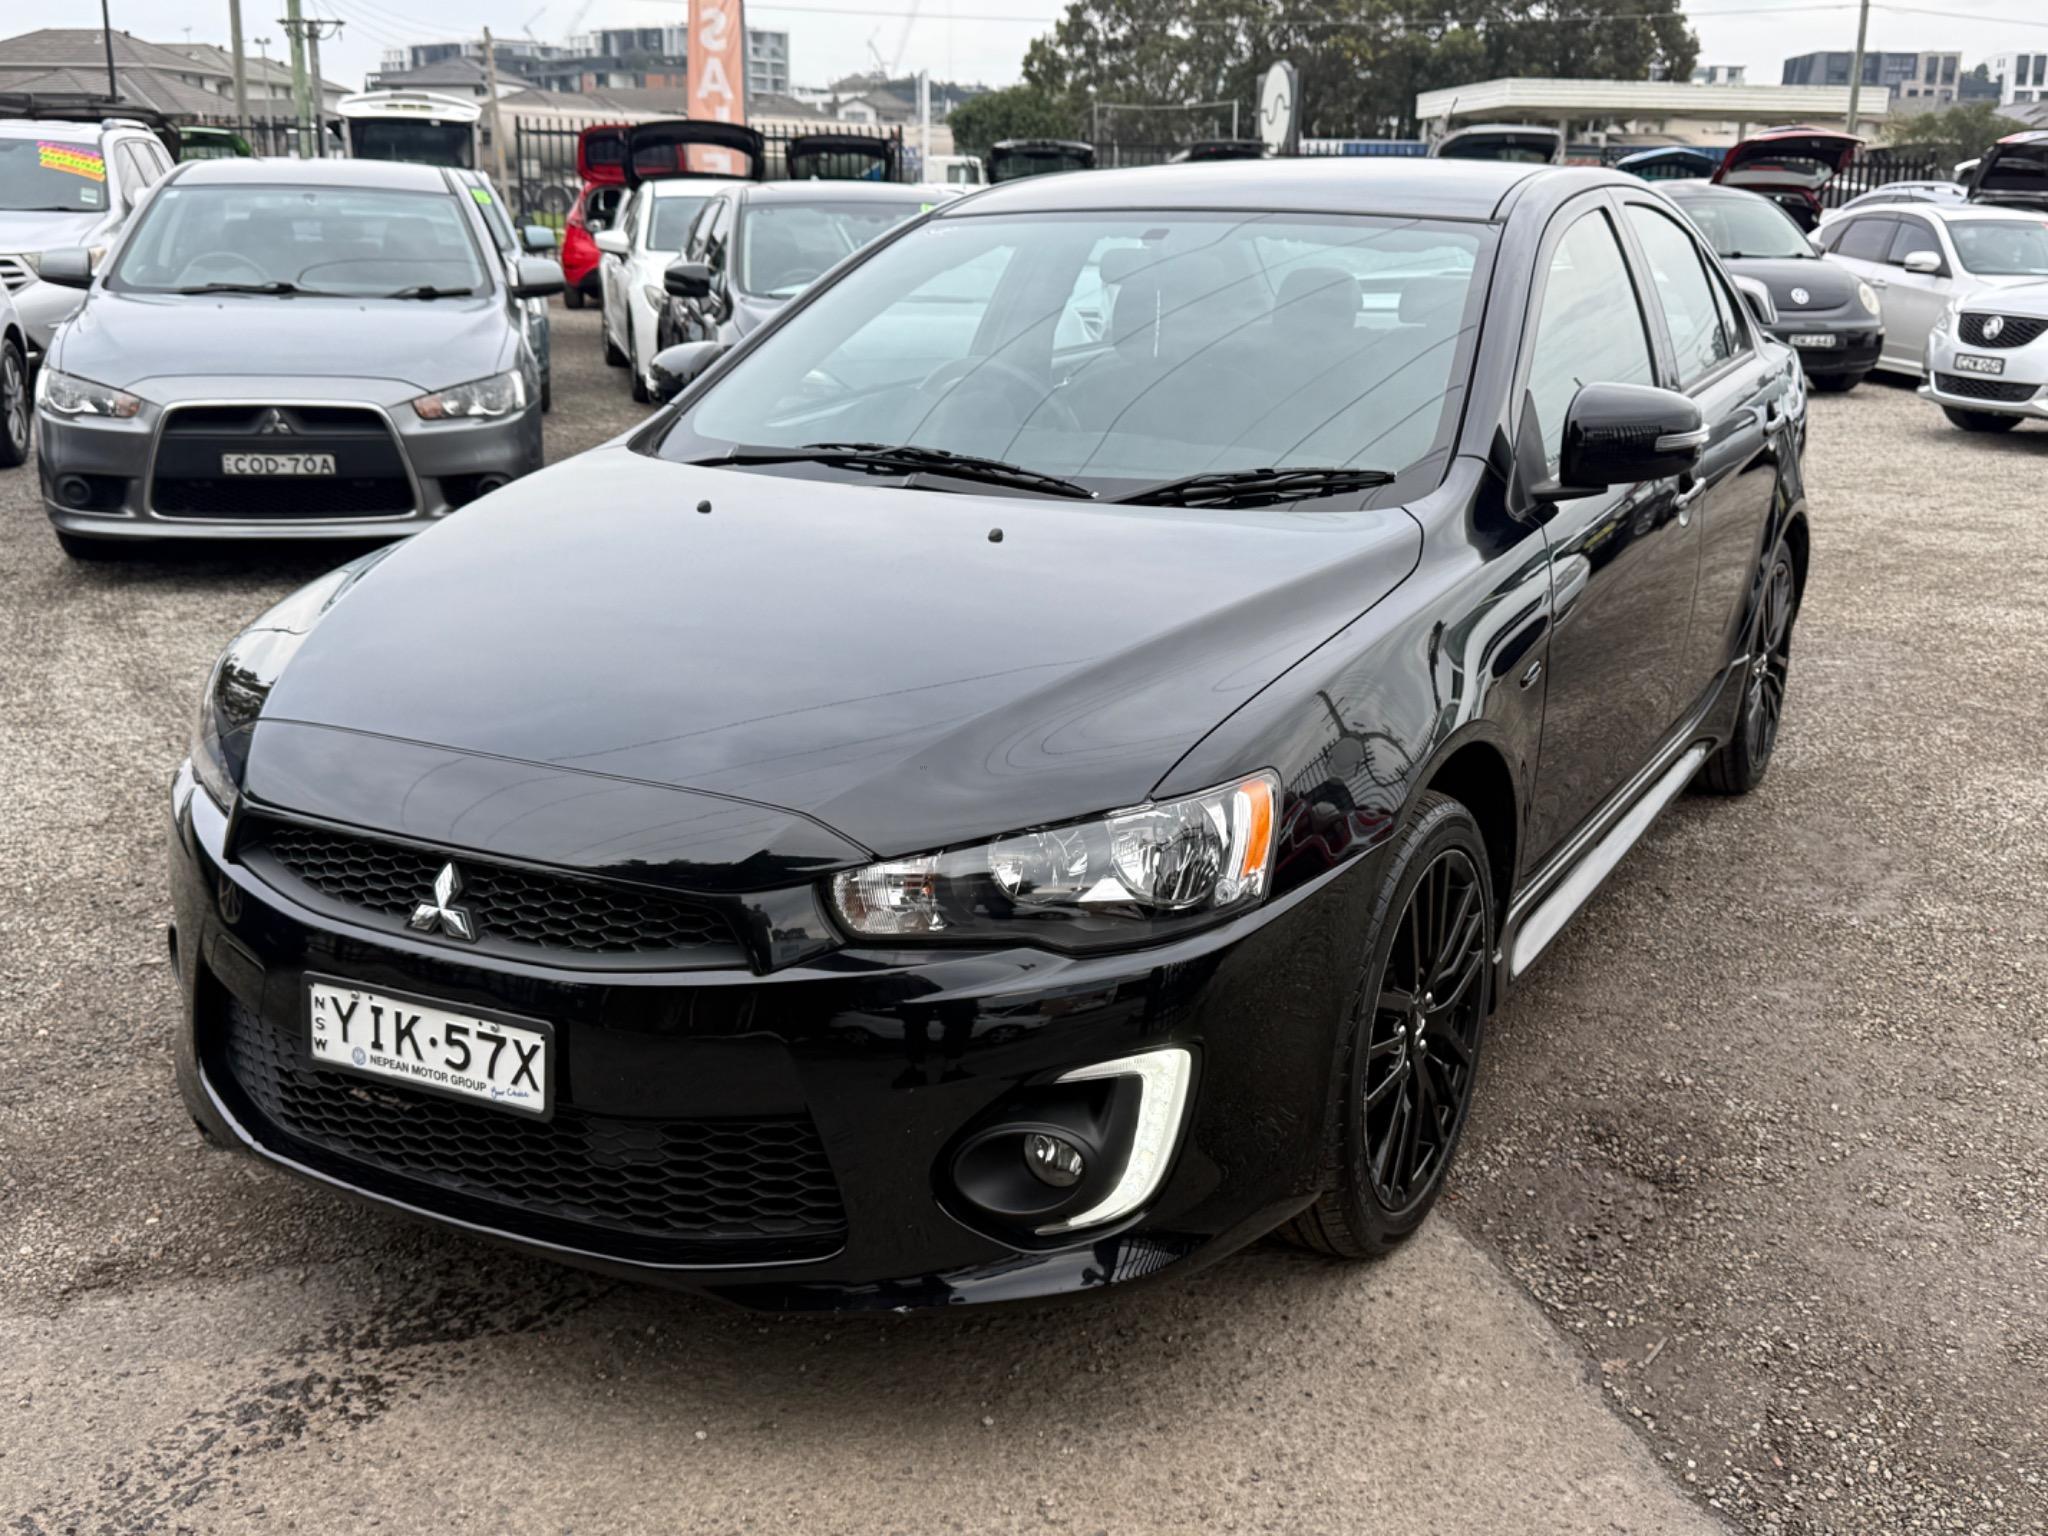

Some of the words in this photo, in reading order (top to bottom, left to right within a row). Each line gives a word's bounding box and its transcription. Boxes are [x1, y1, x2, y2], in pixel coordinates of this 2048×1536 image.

[313, 995, 328, 1052] NSW
[370, 1054, 409, 1073] NEPEAN
[411, 1064, 448, 1082] MOTOR
[450, 1074, 487, 1092] GROUP
